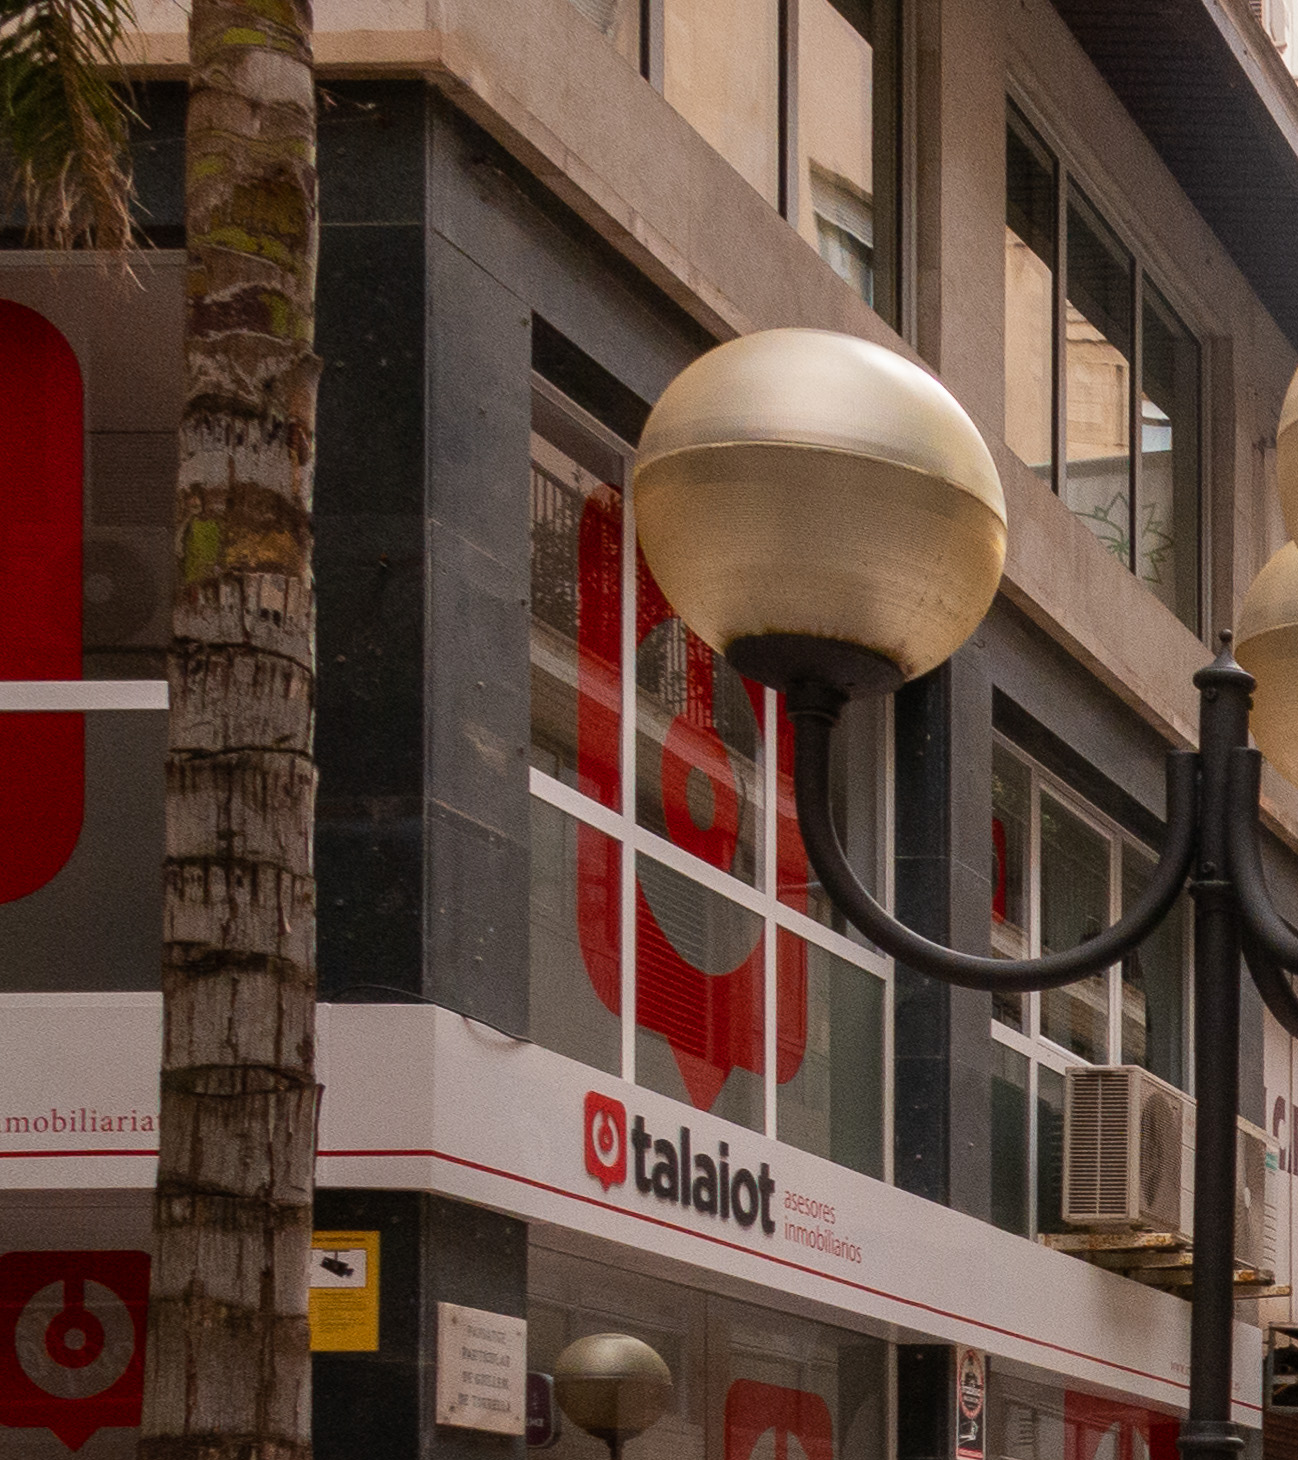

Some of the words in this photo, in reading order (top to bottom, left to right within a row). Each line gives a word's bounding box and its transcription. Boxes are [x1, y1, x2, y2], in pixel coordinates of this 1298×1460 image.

[631, 1114, 776, 1235] talaiot
[783, 1190, 836, 1225] asesores
[783, 1215, 863, 1264] inmobiliarios
